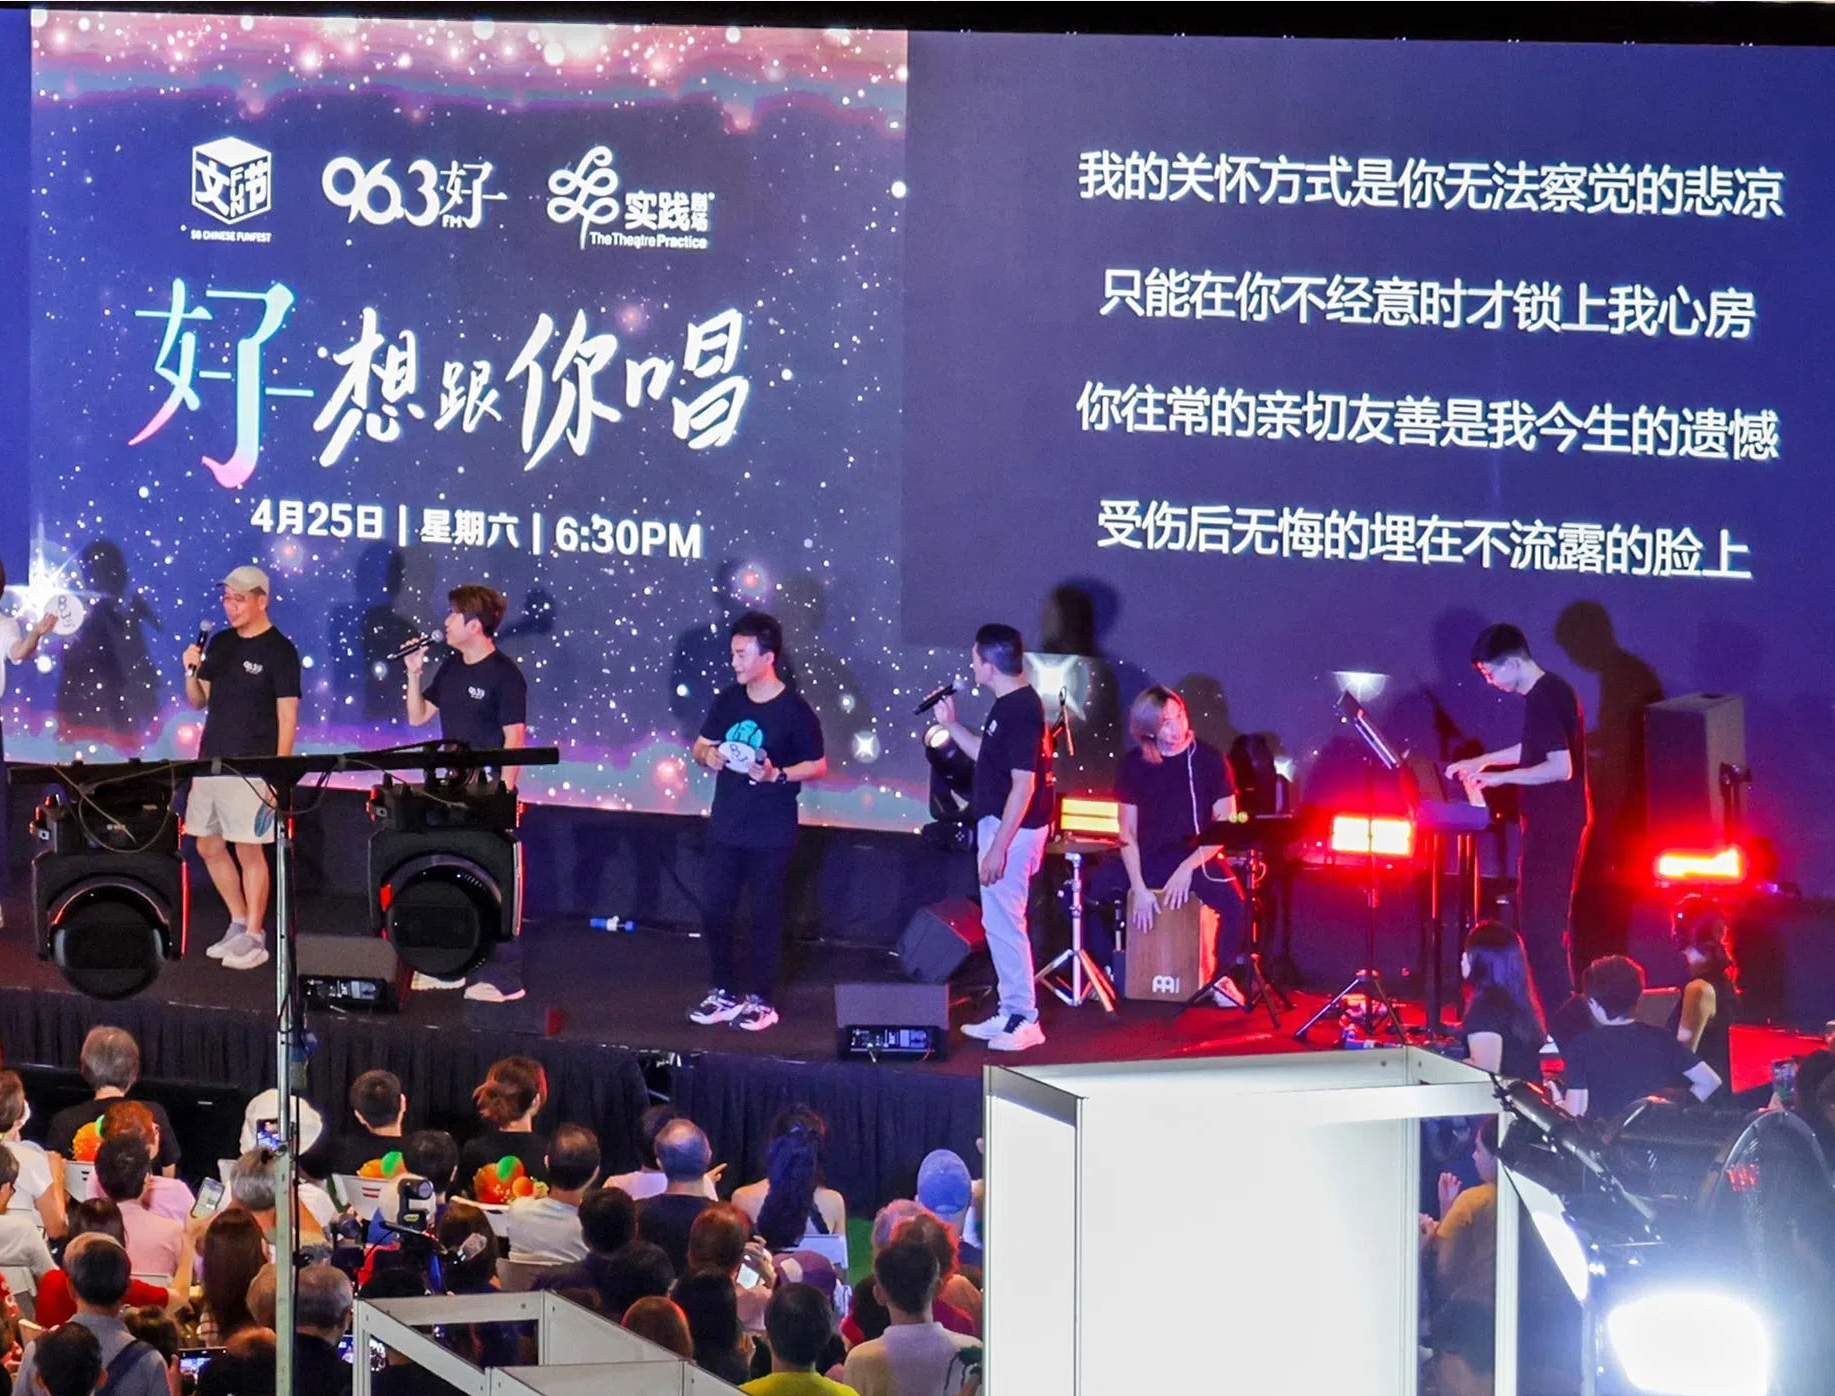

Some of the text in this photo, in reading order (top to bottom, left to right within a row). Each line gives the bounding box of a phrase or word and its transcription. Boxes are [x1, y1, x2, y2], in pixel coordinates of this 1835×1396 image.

[1078, 150, 1785, 220] 我的关怀方式是你无法察觉的悲凉
[1099, 267, 1756, 341] 只能在你不经意时才锁上我心房
[128, 277, 751, 490] 好想跟你唱
[1075, 380, 1781, 461] 你往常的亲切友善是我今生的遗憾
[251, 497, 385, 541] 4月25日
[419, 507, 523, 551] 星期六
[555, 515, 704, 560] 6:30PM
[1097, 499, 1753, 581] 受伤后无悔的埋在不流露的脸上
